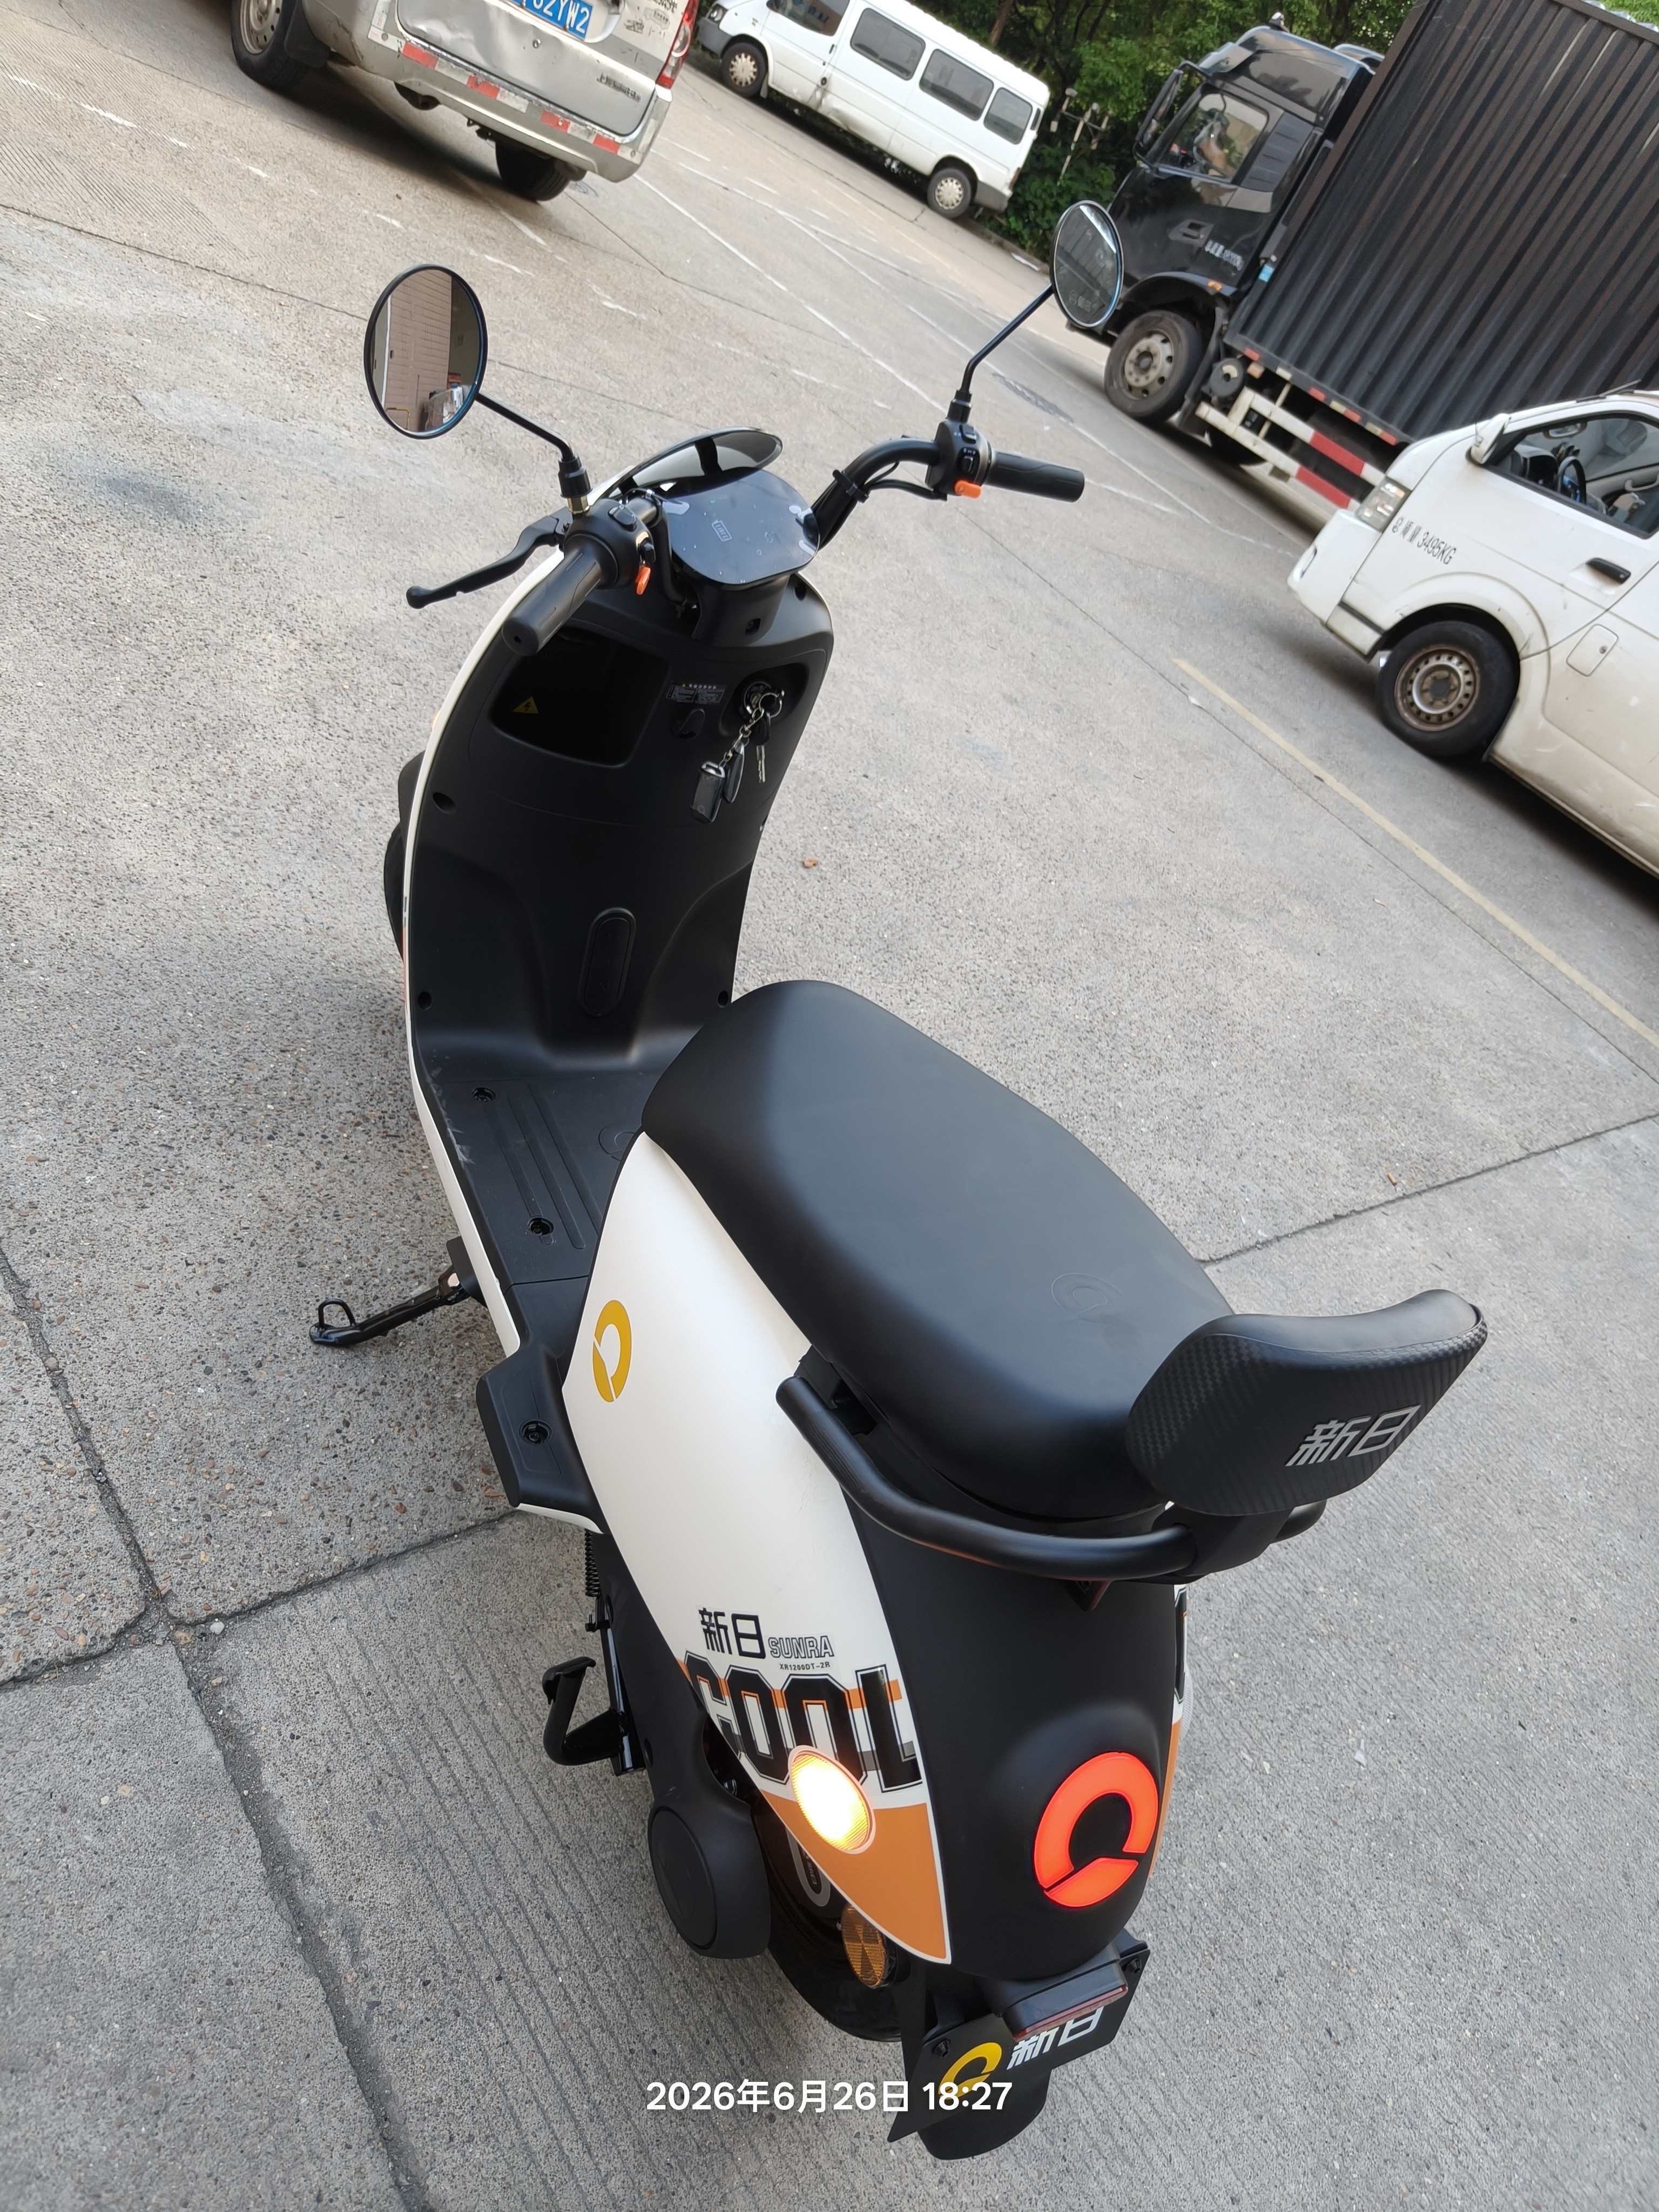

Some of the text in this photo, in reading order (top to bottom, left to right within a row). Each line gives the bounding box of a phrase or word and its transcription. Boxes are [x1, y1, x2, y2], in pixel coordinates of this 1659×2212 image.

[1417, 531, 1456, 565] 3495KG
[1285, 1404, 1422, 1467] 新日
[698, 1607, 835, 1659] 新日 SUNRA
[779, 1661, 831, 1670] XR1200DT-2R
[1006, 2006, 1104, 2071] 新日
